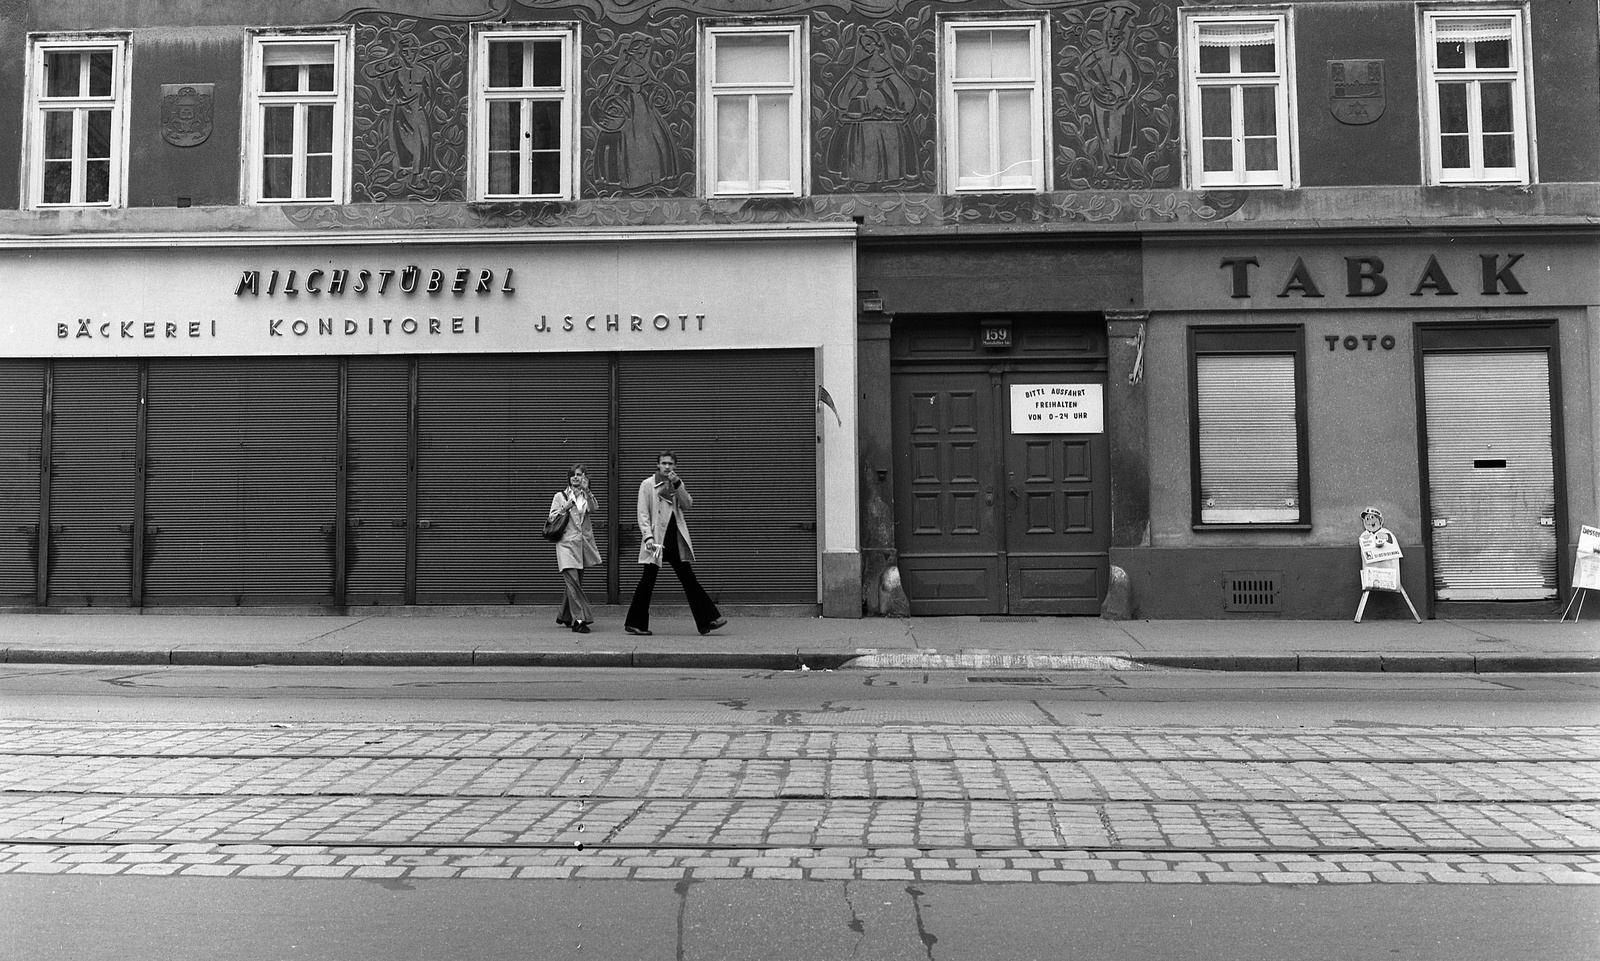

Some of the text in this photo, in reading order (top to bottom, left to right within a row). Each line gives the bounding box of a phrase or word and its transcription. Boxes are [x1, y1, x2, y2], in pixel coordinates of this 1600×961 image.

[234, 265, 516, 296] MILCHSTÜBERL
[1220, 253, 1528, 298] TABAK
[57, 318, 216, 338] BÄCKEREI
[269, 315, 480, 336] KONDITOREI
[985, 327, 1007, 341] 159
[1325, 334, 1396, 351] TOTO
[1025, 388, 1086, 398] BITTE AUSFAHRT
[1035, 401, 1078, 409] FREIHALTEN
[1028, 413, 1042, 421] VON
[1073, 412, 1088, 420] UHR
